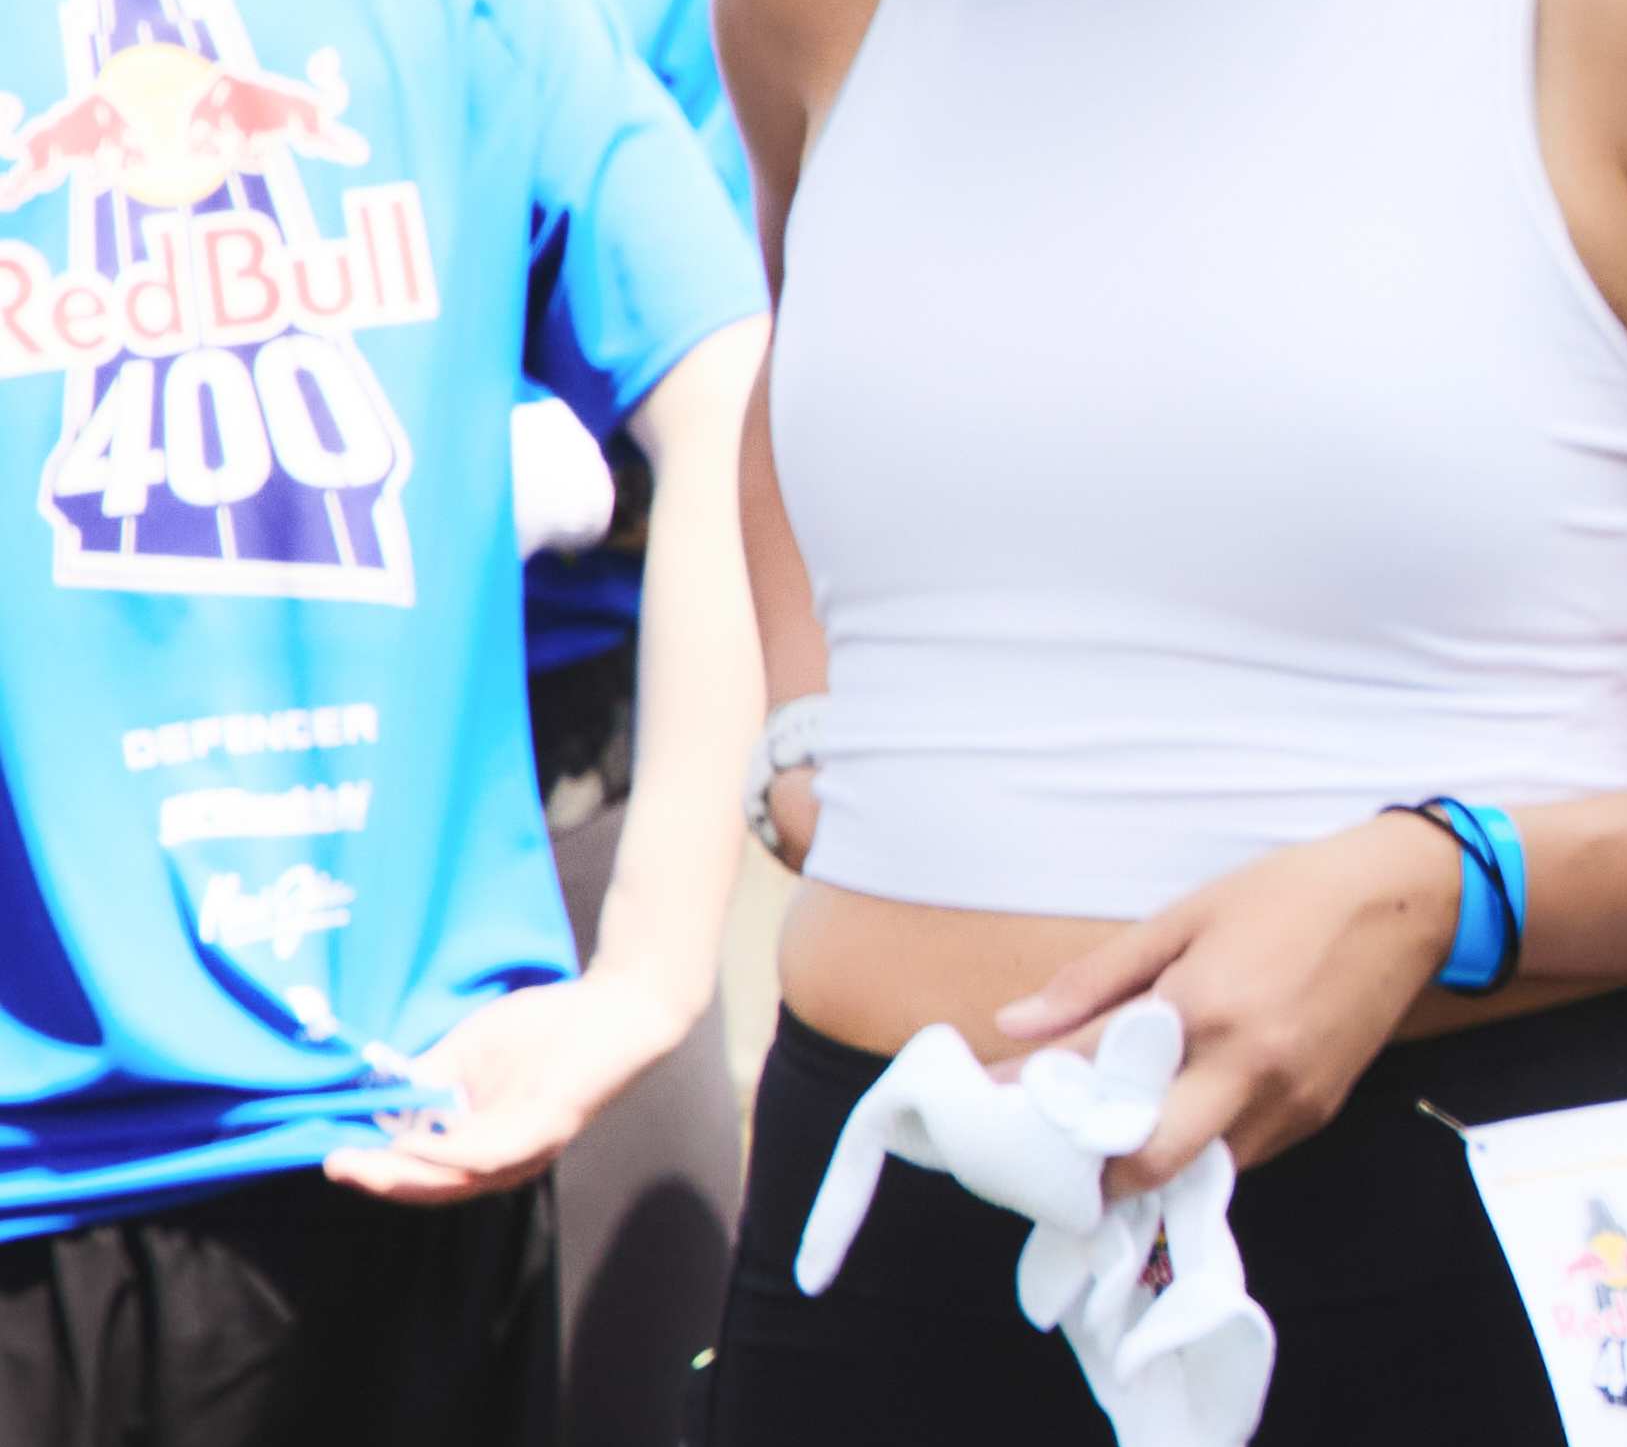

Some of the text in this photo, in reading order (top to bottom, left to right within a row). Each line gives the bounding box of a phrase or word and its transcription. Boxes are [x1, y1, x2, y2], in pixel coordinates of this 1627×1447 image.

[0, 201, 420, 355] Red Bull
[54, 333, 397, 519] 400
[1552, 1289, 1627, 1339] Red
